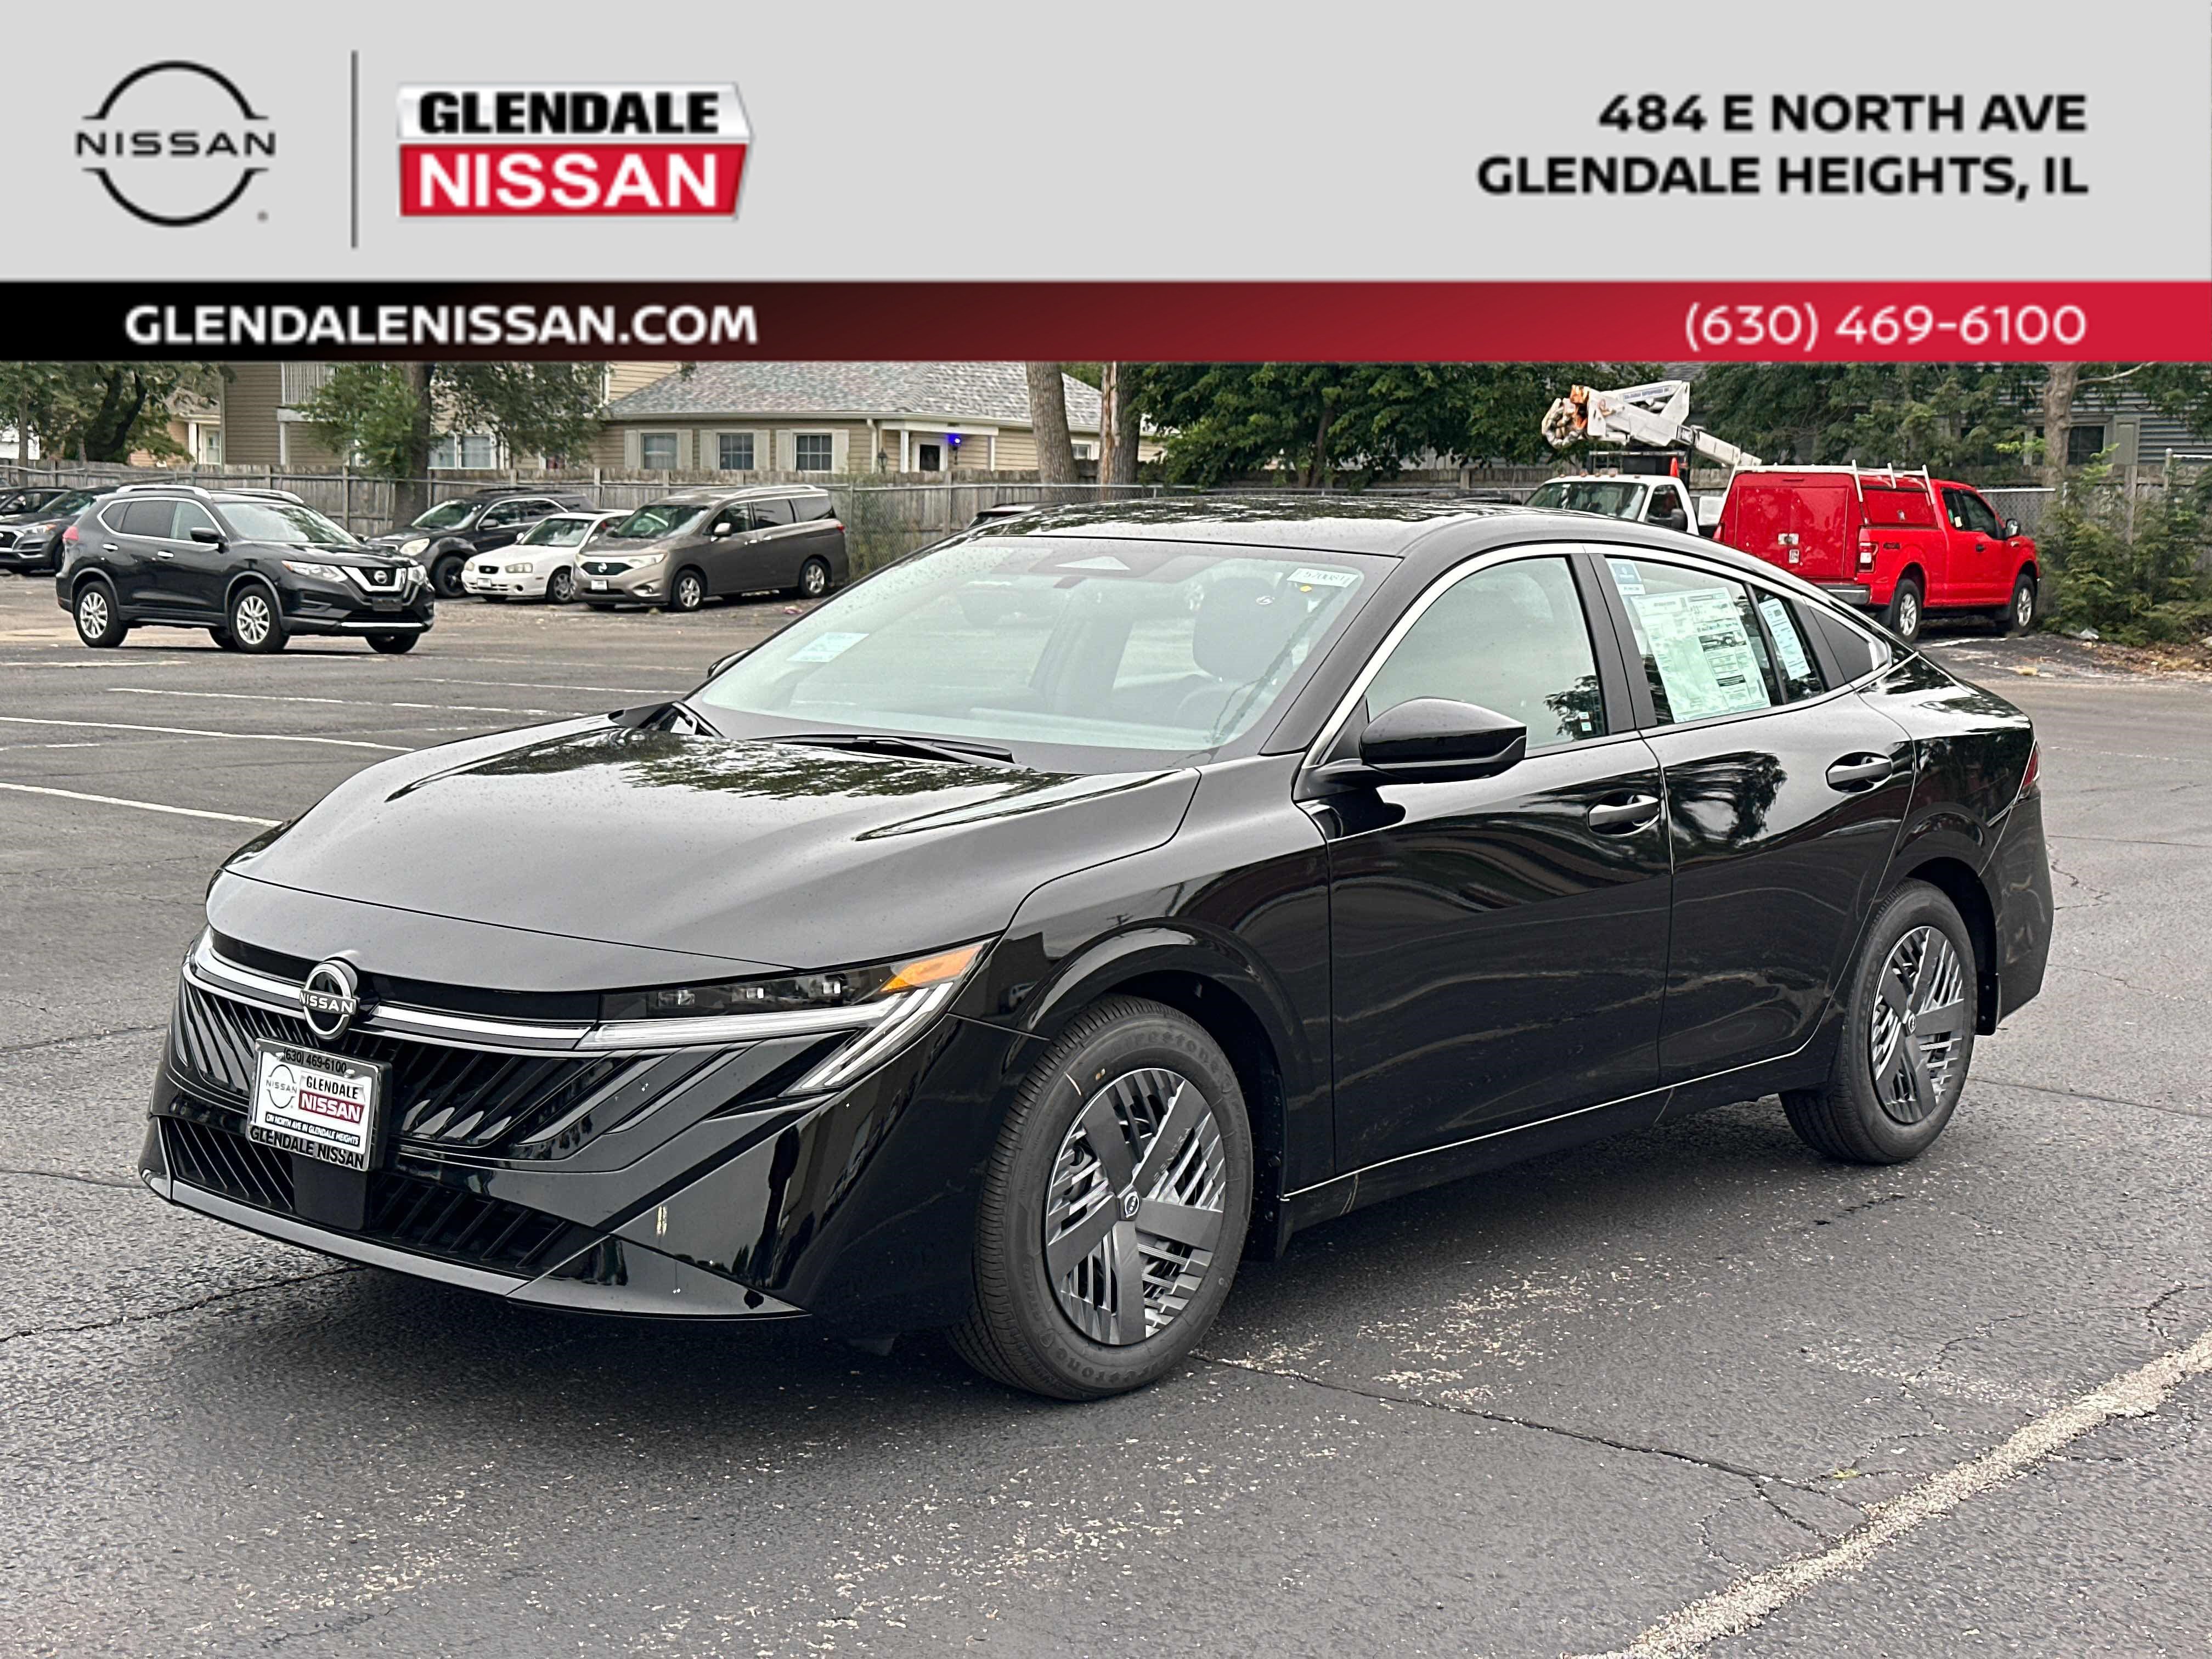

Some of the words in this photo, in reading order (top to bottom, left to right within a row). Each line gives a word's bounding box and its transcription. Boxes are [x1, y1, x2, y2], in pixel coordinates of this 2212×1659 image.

[299, 992, 353, 1013] NISSAN
[284, 1048, 304, 1064] (630)
[306, 1054, 347, 1074] 469-6100
[266, 1079, 297, 1094] NISSAN
[306, 1075, 359, 1099] GLENDALE
[301, 1093, 360, 1122] NISSAN
[274, 1116, 291, 1127] NORTH
[291, 1120, 301, 1129] AVE
[308, 1125, 336, 1139] GLENDALE
[335, 1132, 360, 1145] HEIGHTS
[251, 1125, 315, 1156] GLENDALE
[317, 1143, 365, 1170] NISSAN
